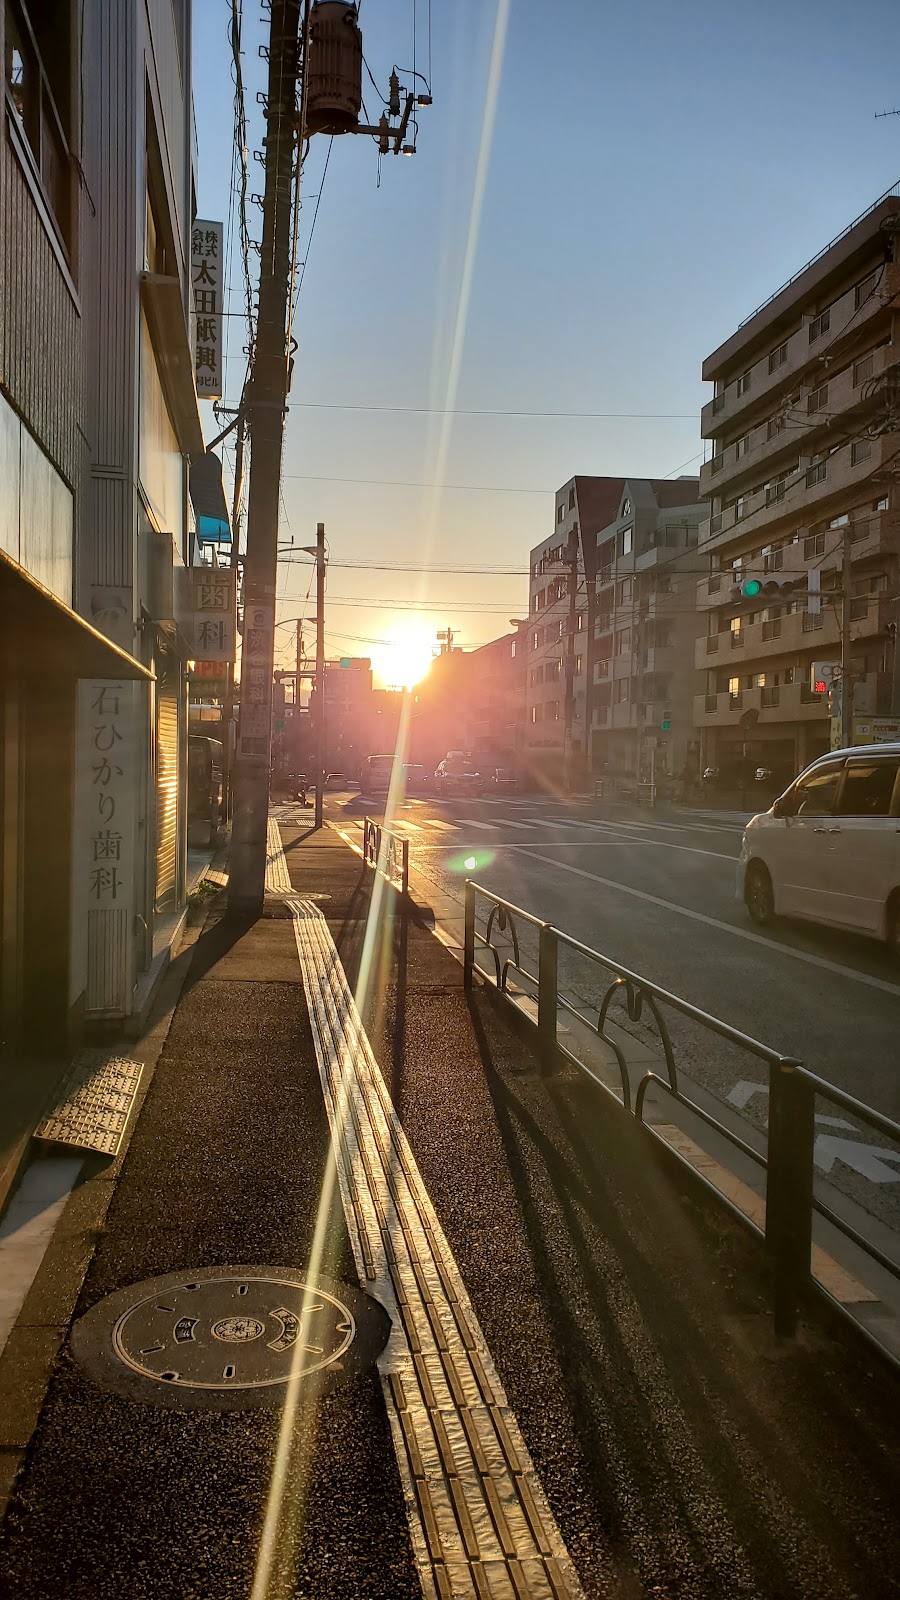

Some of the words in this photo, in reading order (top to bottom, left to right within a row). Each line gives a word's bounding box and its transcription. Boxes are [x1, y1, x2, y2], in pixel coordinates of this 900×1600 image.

[196, 574, 231, 651] 歯科
[248, 631, 267, 704] 渋谷眼科
[89, 685, 124, 899] 石ひかり歯科
